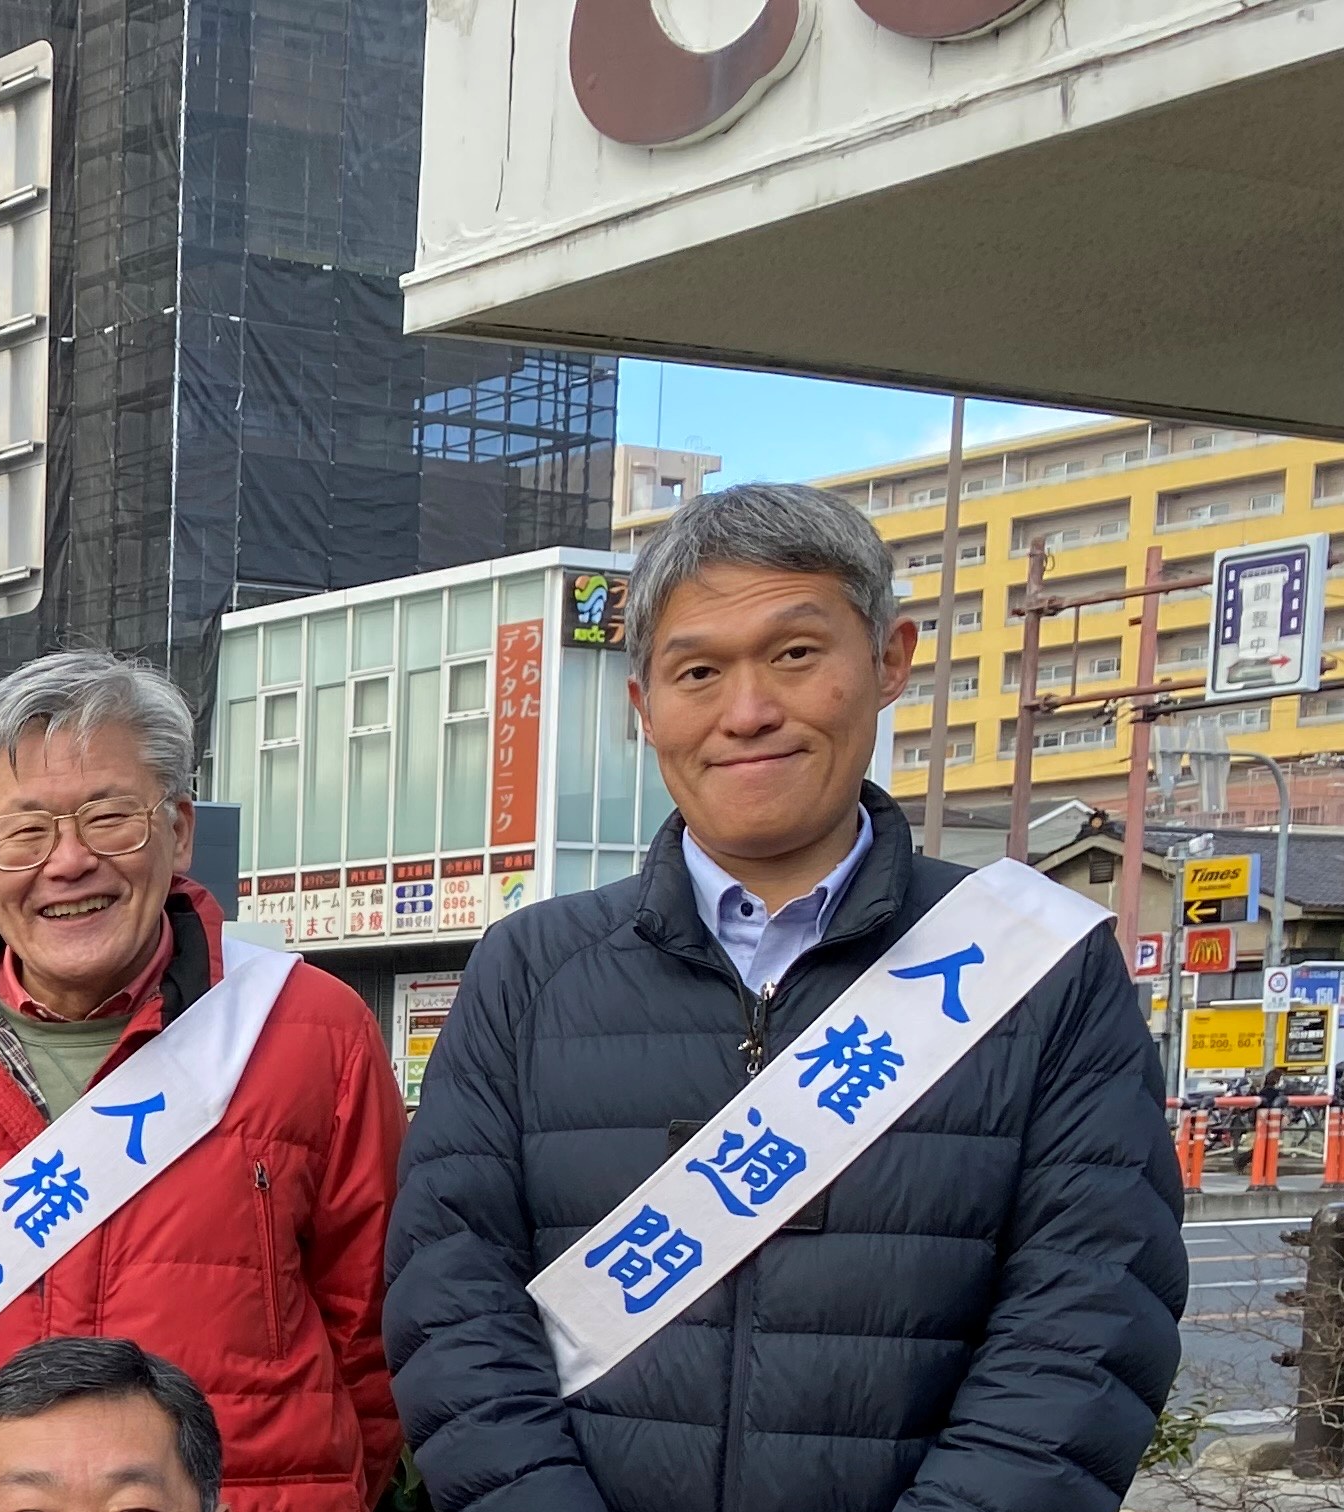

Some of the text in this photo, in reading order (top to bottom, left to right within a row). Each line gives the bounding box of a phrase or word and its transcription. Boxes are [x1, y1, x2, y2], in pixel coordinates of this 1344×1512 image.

[520, 624, 541, 719] うらた
[496, 628, 520, 833] デンタルクリニック
[442, 912, 476, 926] 4148
[1190, 867, 1242, 884] Times
[584, 942, 986, 1314] 人権週間
